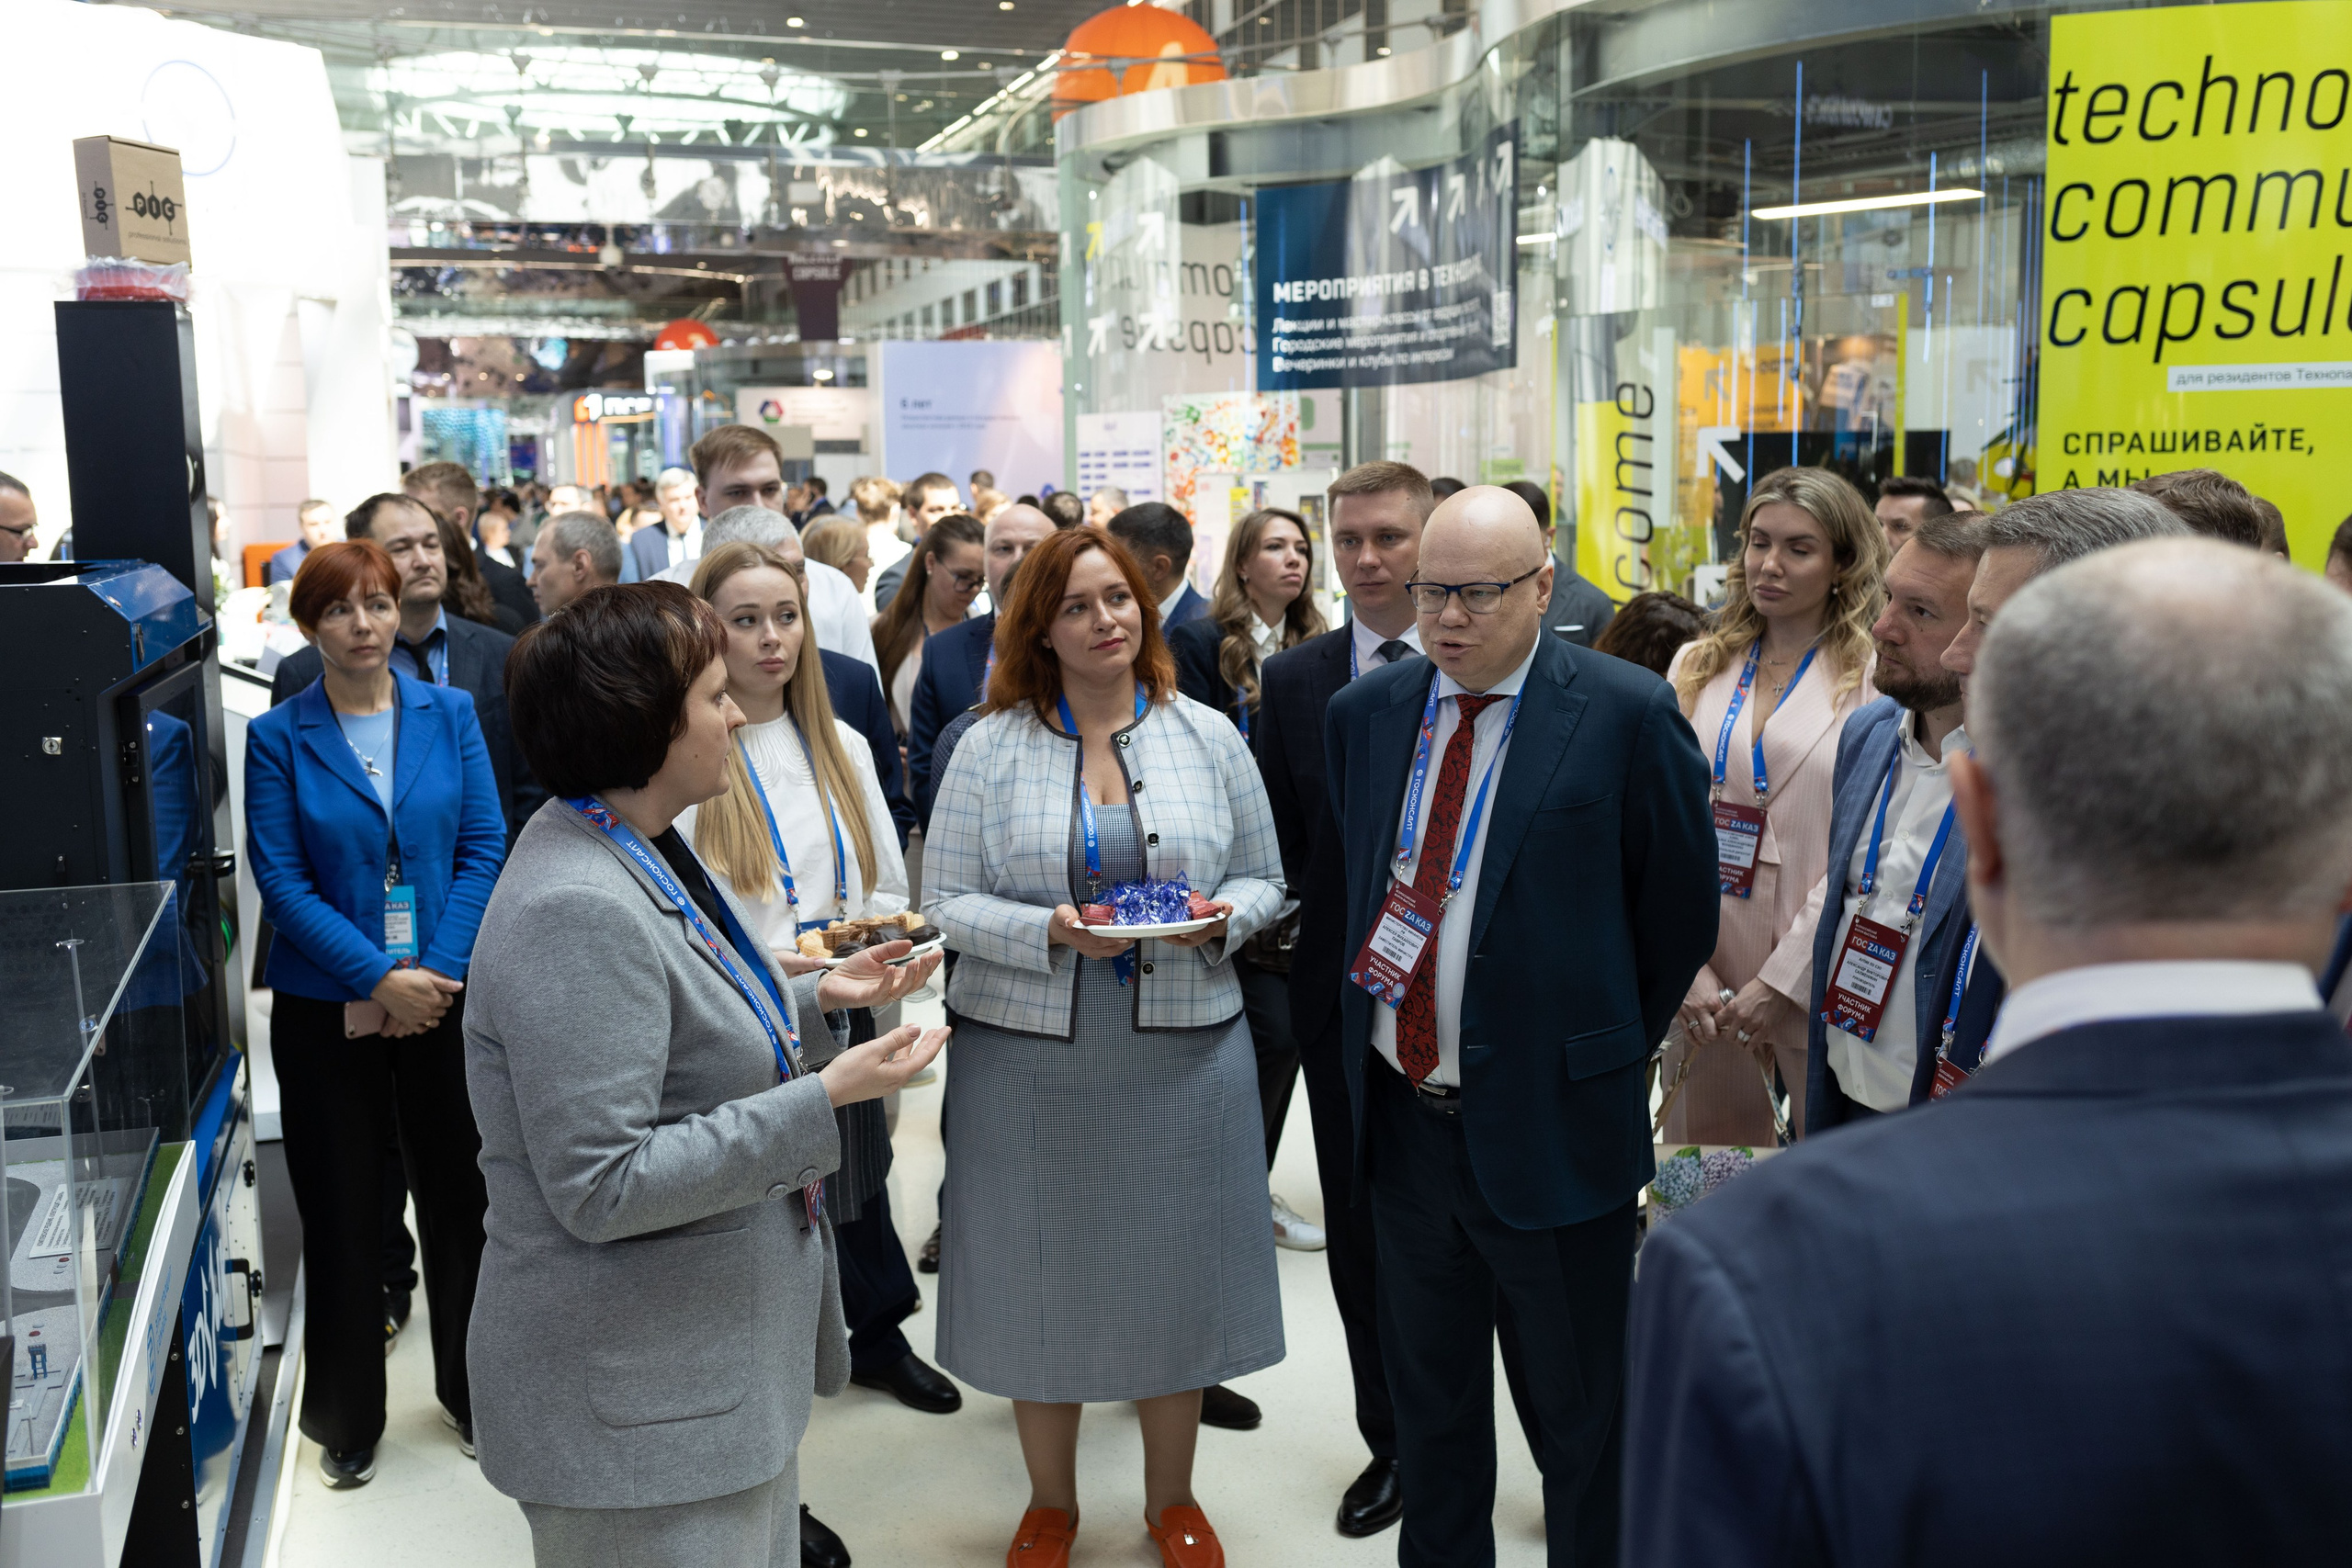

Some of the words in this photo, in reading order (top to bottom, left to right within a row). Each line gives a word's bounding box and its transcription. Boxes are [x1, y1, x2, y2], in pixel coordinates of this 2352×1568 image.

[2053, 54, 2350, 146] techno
[1272, 270, 1416, 304] МЕРОПРИЯТИЯ
[1418, 267, 1430, 291] В
[2049, 254, 2352, 365] capsul
[1272, 317, 1325, 334] Лекции
[1325, 317, 1337, 331] и
[1272, 336, 1344, 355] Городские
[1345, 331, 1418, 352] мероприятия
[1272, 356, 1347, 374] Вечеринки
[1347, 355, 1358, 369] и
[1358, 351, 1395, 371] клубы
[2176, 373, 2203, 386] для
[2207, 369, 2292, 386] резидентов
[2064, 423, 2314, 457] СПРАШИВАЙТЕ,
[2064, 468, 2080, 490] А
[1717, 719, 1732, 763] ГОСКОНСАЛТ
[1406, 778, 1421, 831] ГОСКОНСАЛТ
[1083, 796, 1095, 839] ГОСКОНСАЛТ
[626, 840, 678, 897] ГОСКОНСАЛТ
[1719, 866, 1744, 877] АСТНИК
[1390, 901, 1406, 916] ГОС
[1385, 916, 1408, 931] МИНИСТЕРСТВО
[1378, 935, 1397, 951] ЗАМЕСТИТЕЛЬ
[1382, 925, 1397, 936] АЛЕКСЕЙ
[1396, 932, 1419, 950] МИХАЙЛОВИЧ
[1391, 936, 1406, 947] ЛАВРОВ
[1851, 935, 1868, 949] ГОС
[1369, 955, 1402, 981] УЧАСТНИК
[1847, 960, 1867, 972] АЛЕКСАНДР
[1954, 931, 1975, 998] ГОСКОНСАЛТ
[1368, 966, 1394, 988] ФОРУМА
[735, 974, 773, 1033] ГОСКОНСАЛТ
[1837, 1003, 1865, 1021] ФОРУМА
[1838, 992, 1871, 1014] УЧАСТНИК
